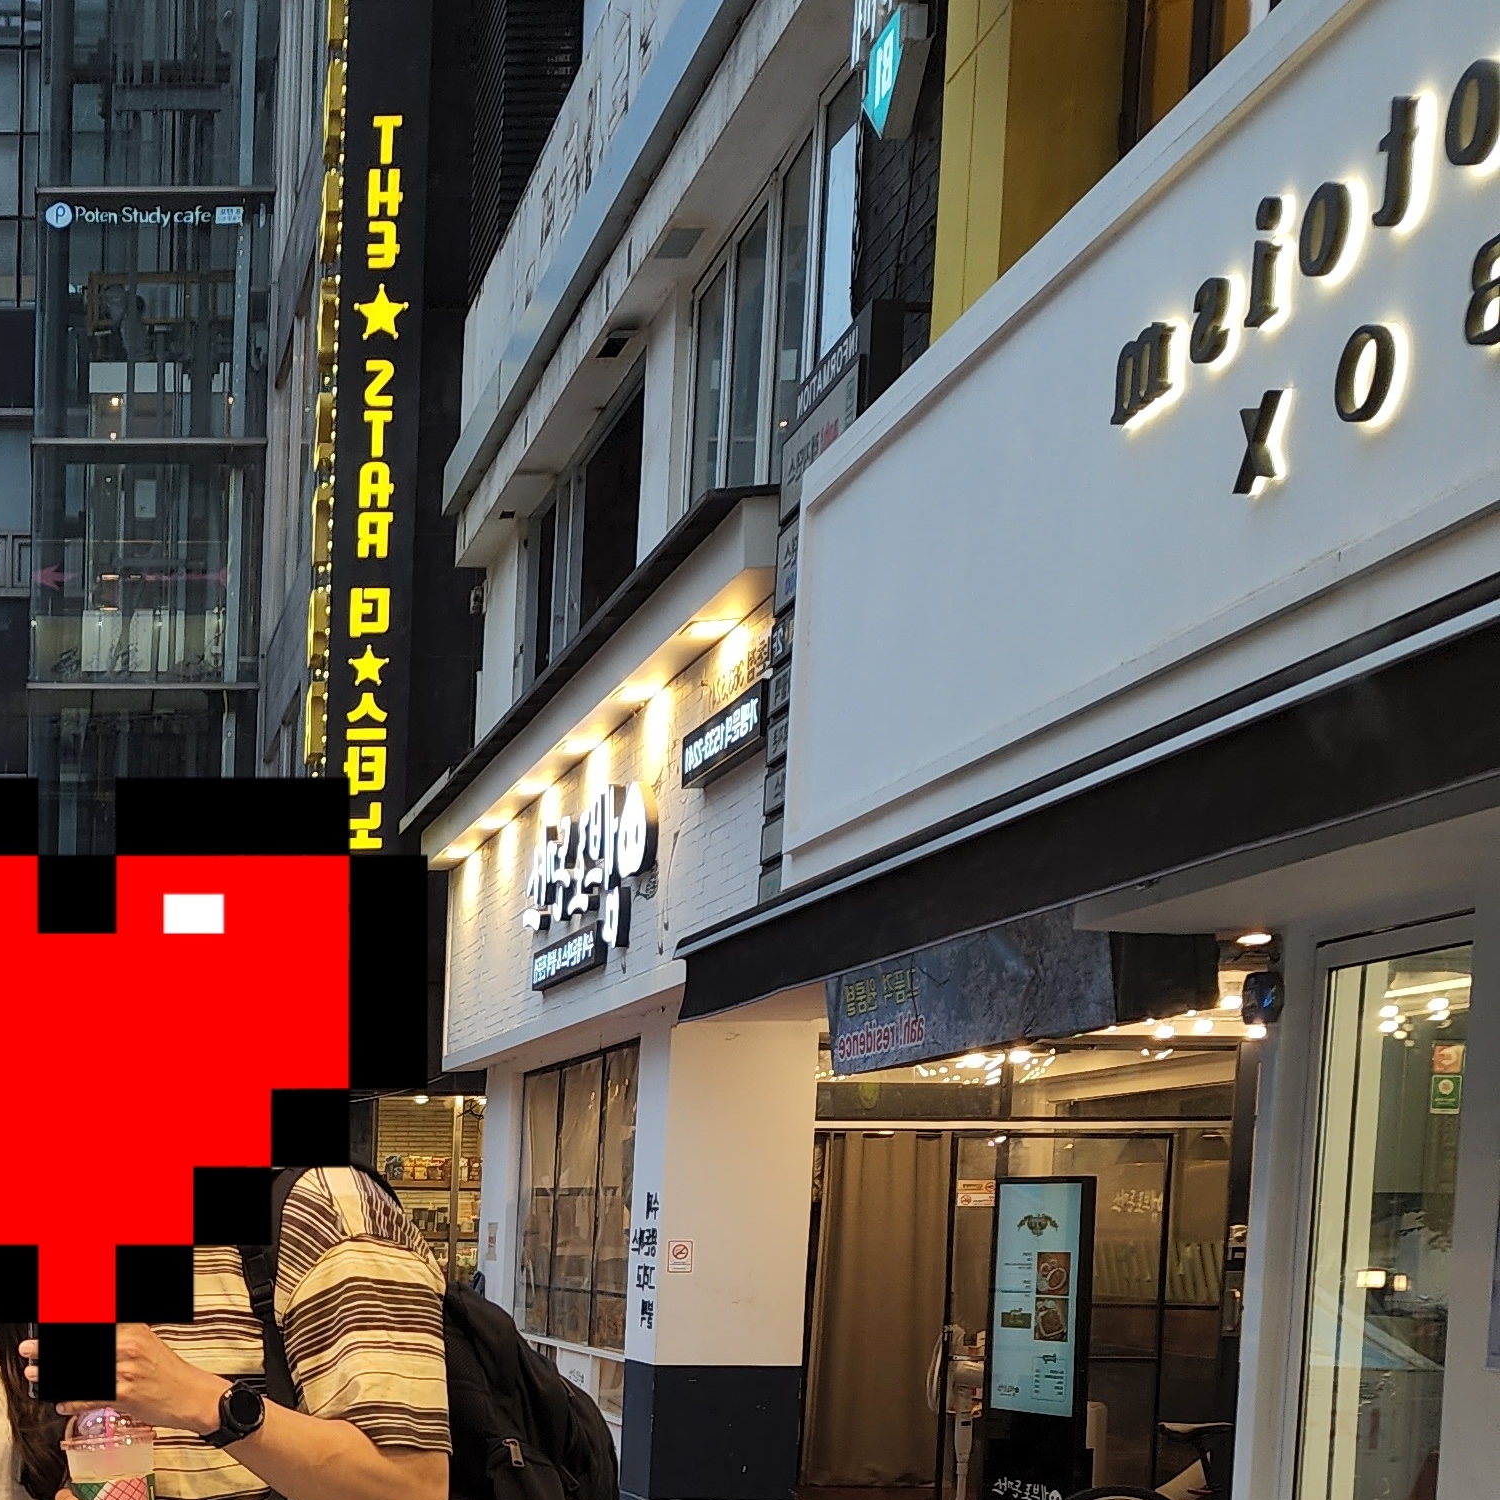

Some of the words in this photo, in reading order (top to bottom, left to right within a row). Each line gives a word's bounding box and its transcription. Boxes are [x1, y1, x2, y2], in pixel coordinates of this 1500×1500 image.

[74, 205, 118, 225] Poten
[120, 205, 171, 227] Study
[173, 204, 212, 226] cafe
